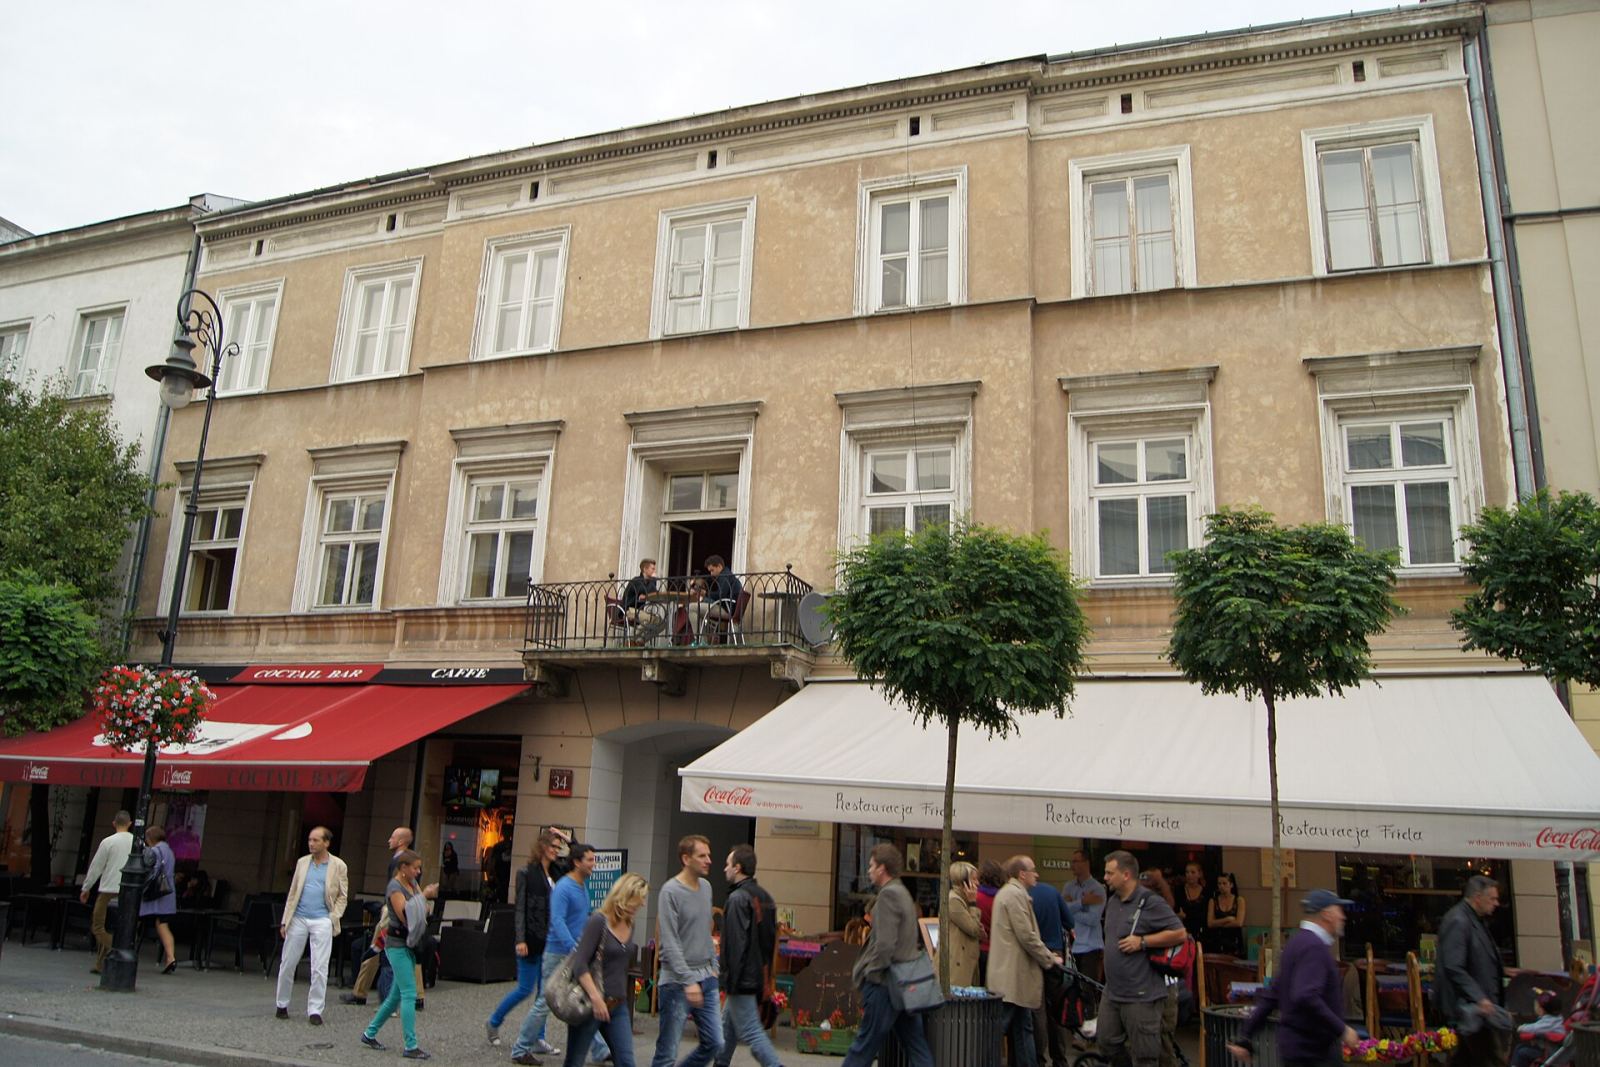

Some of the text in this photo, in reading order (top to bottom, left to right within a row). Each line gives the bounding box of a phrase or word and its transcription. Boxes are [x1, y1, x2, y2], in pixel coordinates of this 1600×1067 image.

[253, 668, 363, 679] COCTAIL BAR
[431, 668, 490, 679] CAFFE
[226, 767, 299, 786] COCTAIL
[552, 775, 568, 790] 34
[762, 800, 785, 810] dobrym
[835, 791, 913, 824] Restauracja
[1046, 803, 1181, 836] Restauracja Frida
[1278, 815, 1423, 849] Restauracja Frida
[1476, 839, 1504, 848] dobrym
[1506, 840, 1531, 848] smaku
